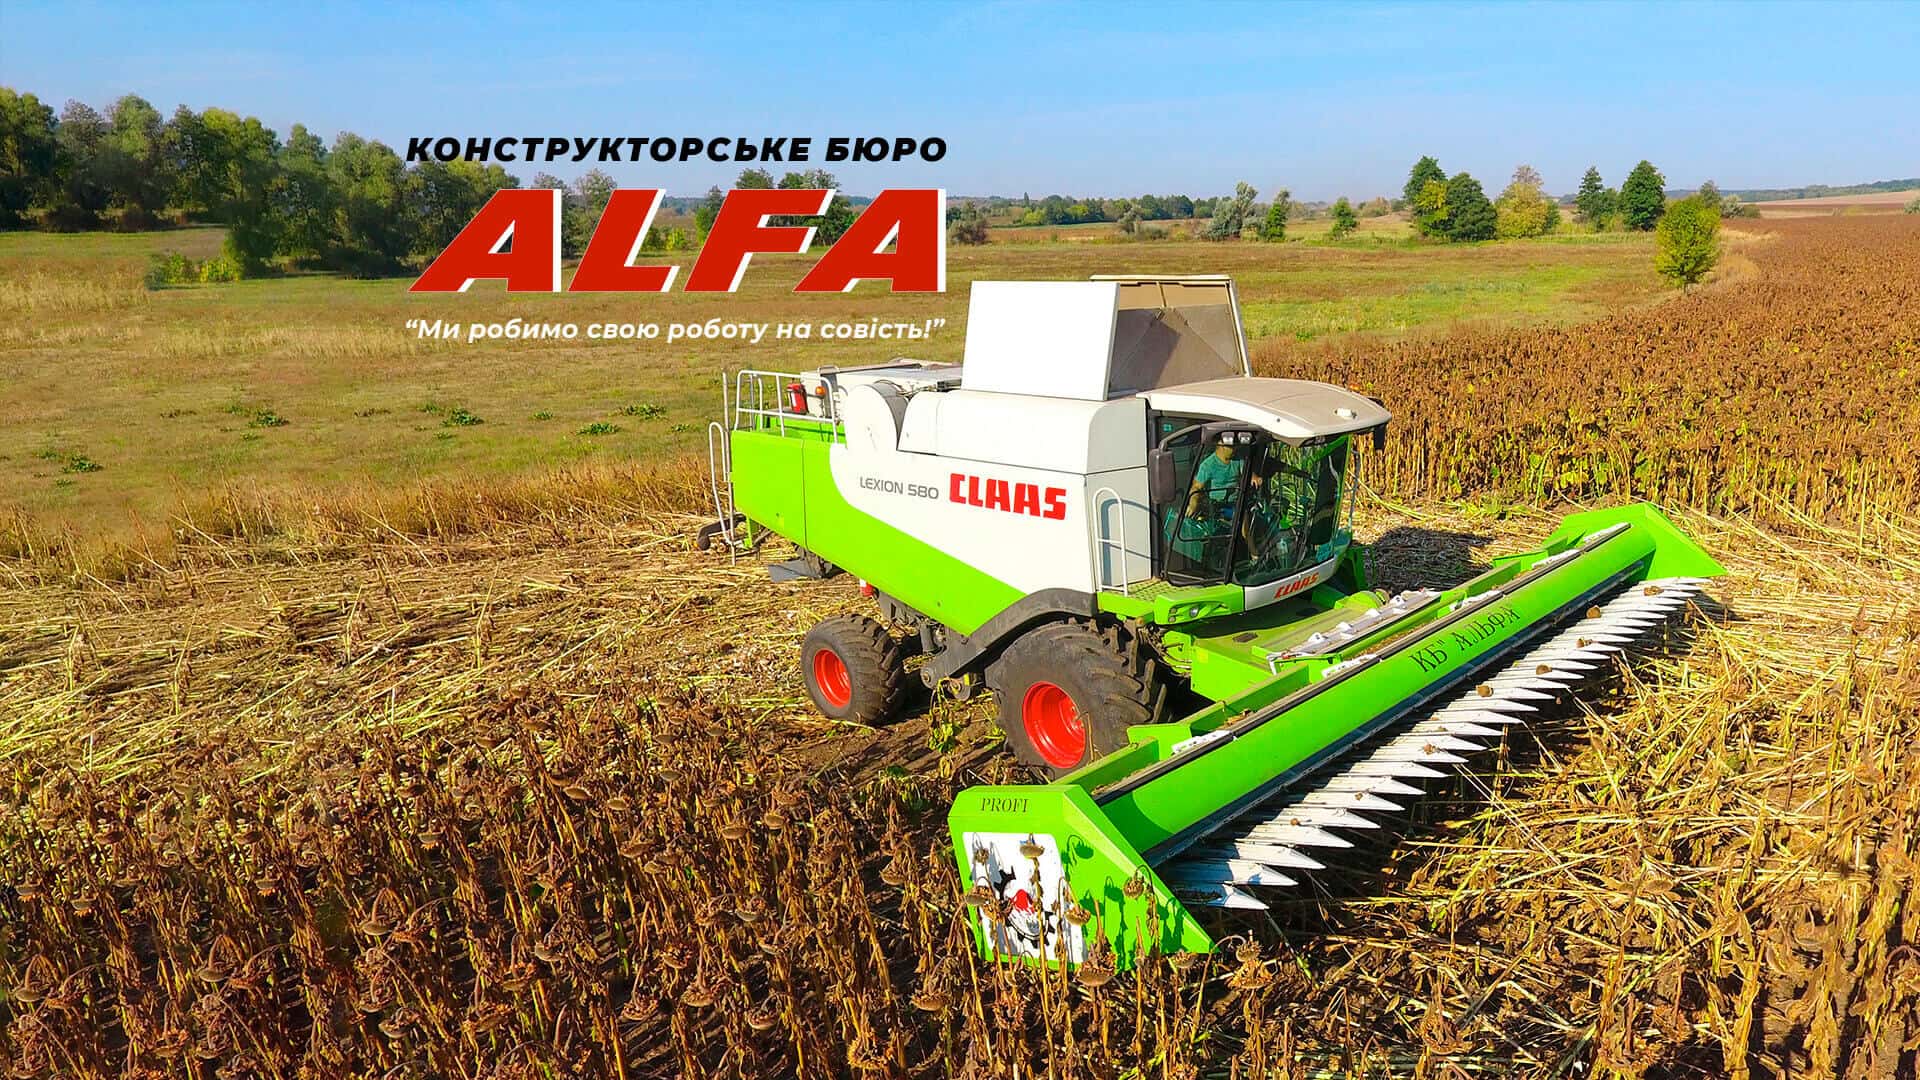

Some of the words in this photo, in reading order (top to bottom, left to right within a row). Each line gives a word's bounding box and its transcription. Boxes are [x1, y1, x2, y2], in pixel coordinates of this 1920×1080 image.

[859, 476, 904, 495] LEXION
[907, 484, 939, 500] 580
[949, 473, 1067, 520] CLAAS
[1274, 572, 1319, 599] CLAAS
[1451, 606, 1521, 651] АЛЬФА
[981, 797, 1028, 813] PROFI
